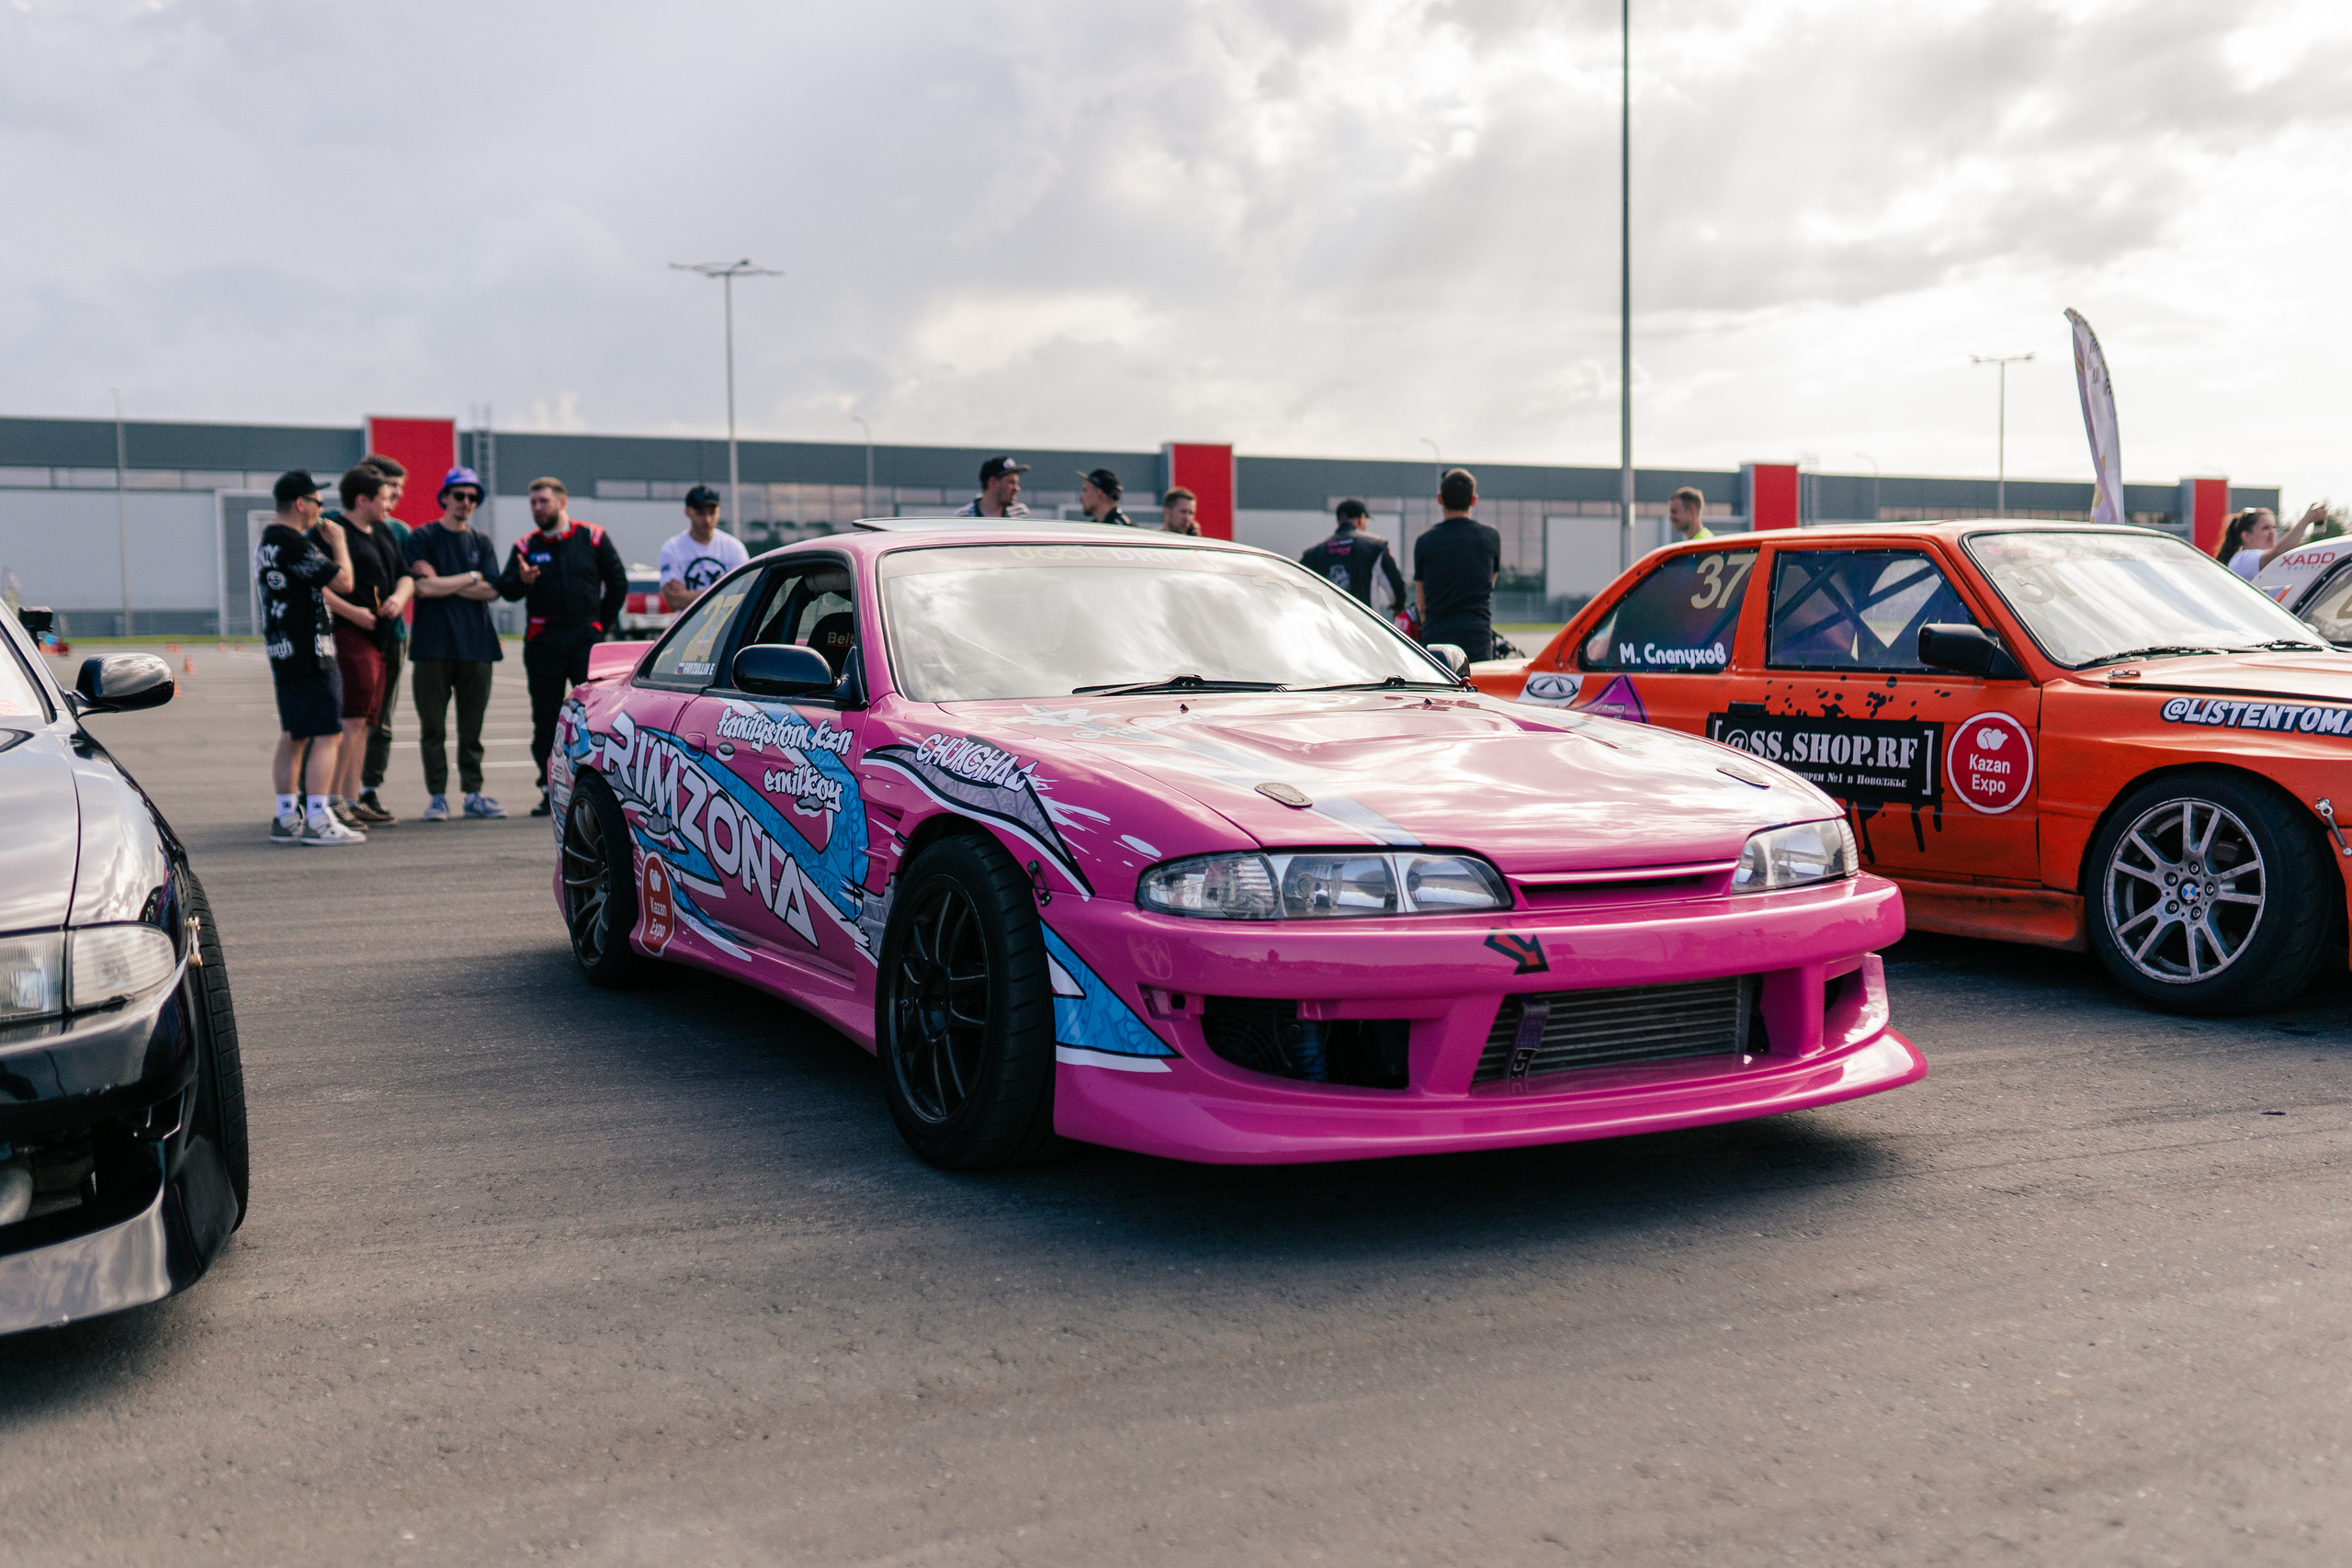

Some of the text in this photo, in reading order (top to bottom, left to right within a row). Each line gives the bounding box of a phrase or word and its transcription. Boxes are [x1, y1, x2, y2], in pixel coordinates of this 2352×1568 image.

[1690, 553, 1758, 610] 37
[682, 592, 745, 662] 27
[1620, 642, 1641, 664] М.
[1969, 753, 2010, 774] Kazan
[1827, 772, 1843, 784] №1
[1972, 773, 2006, 796] Expo
[603, 709, 820, 950] RIMZONA
[650, 897, 667, 918] Kazan
[649, 918, 666, 941] Expo
